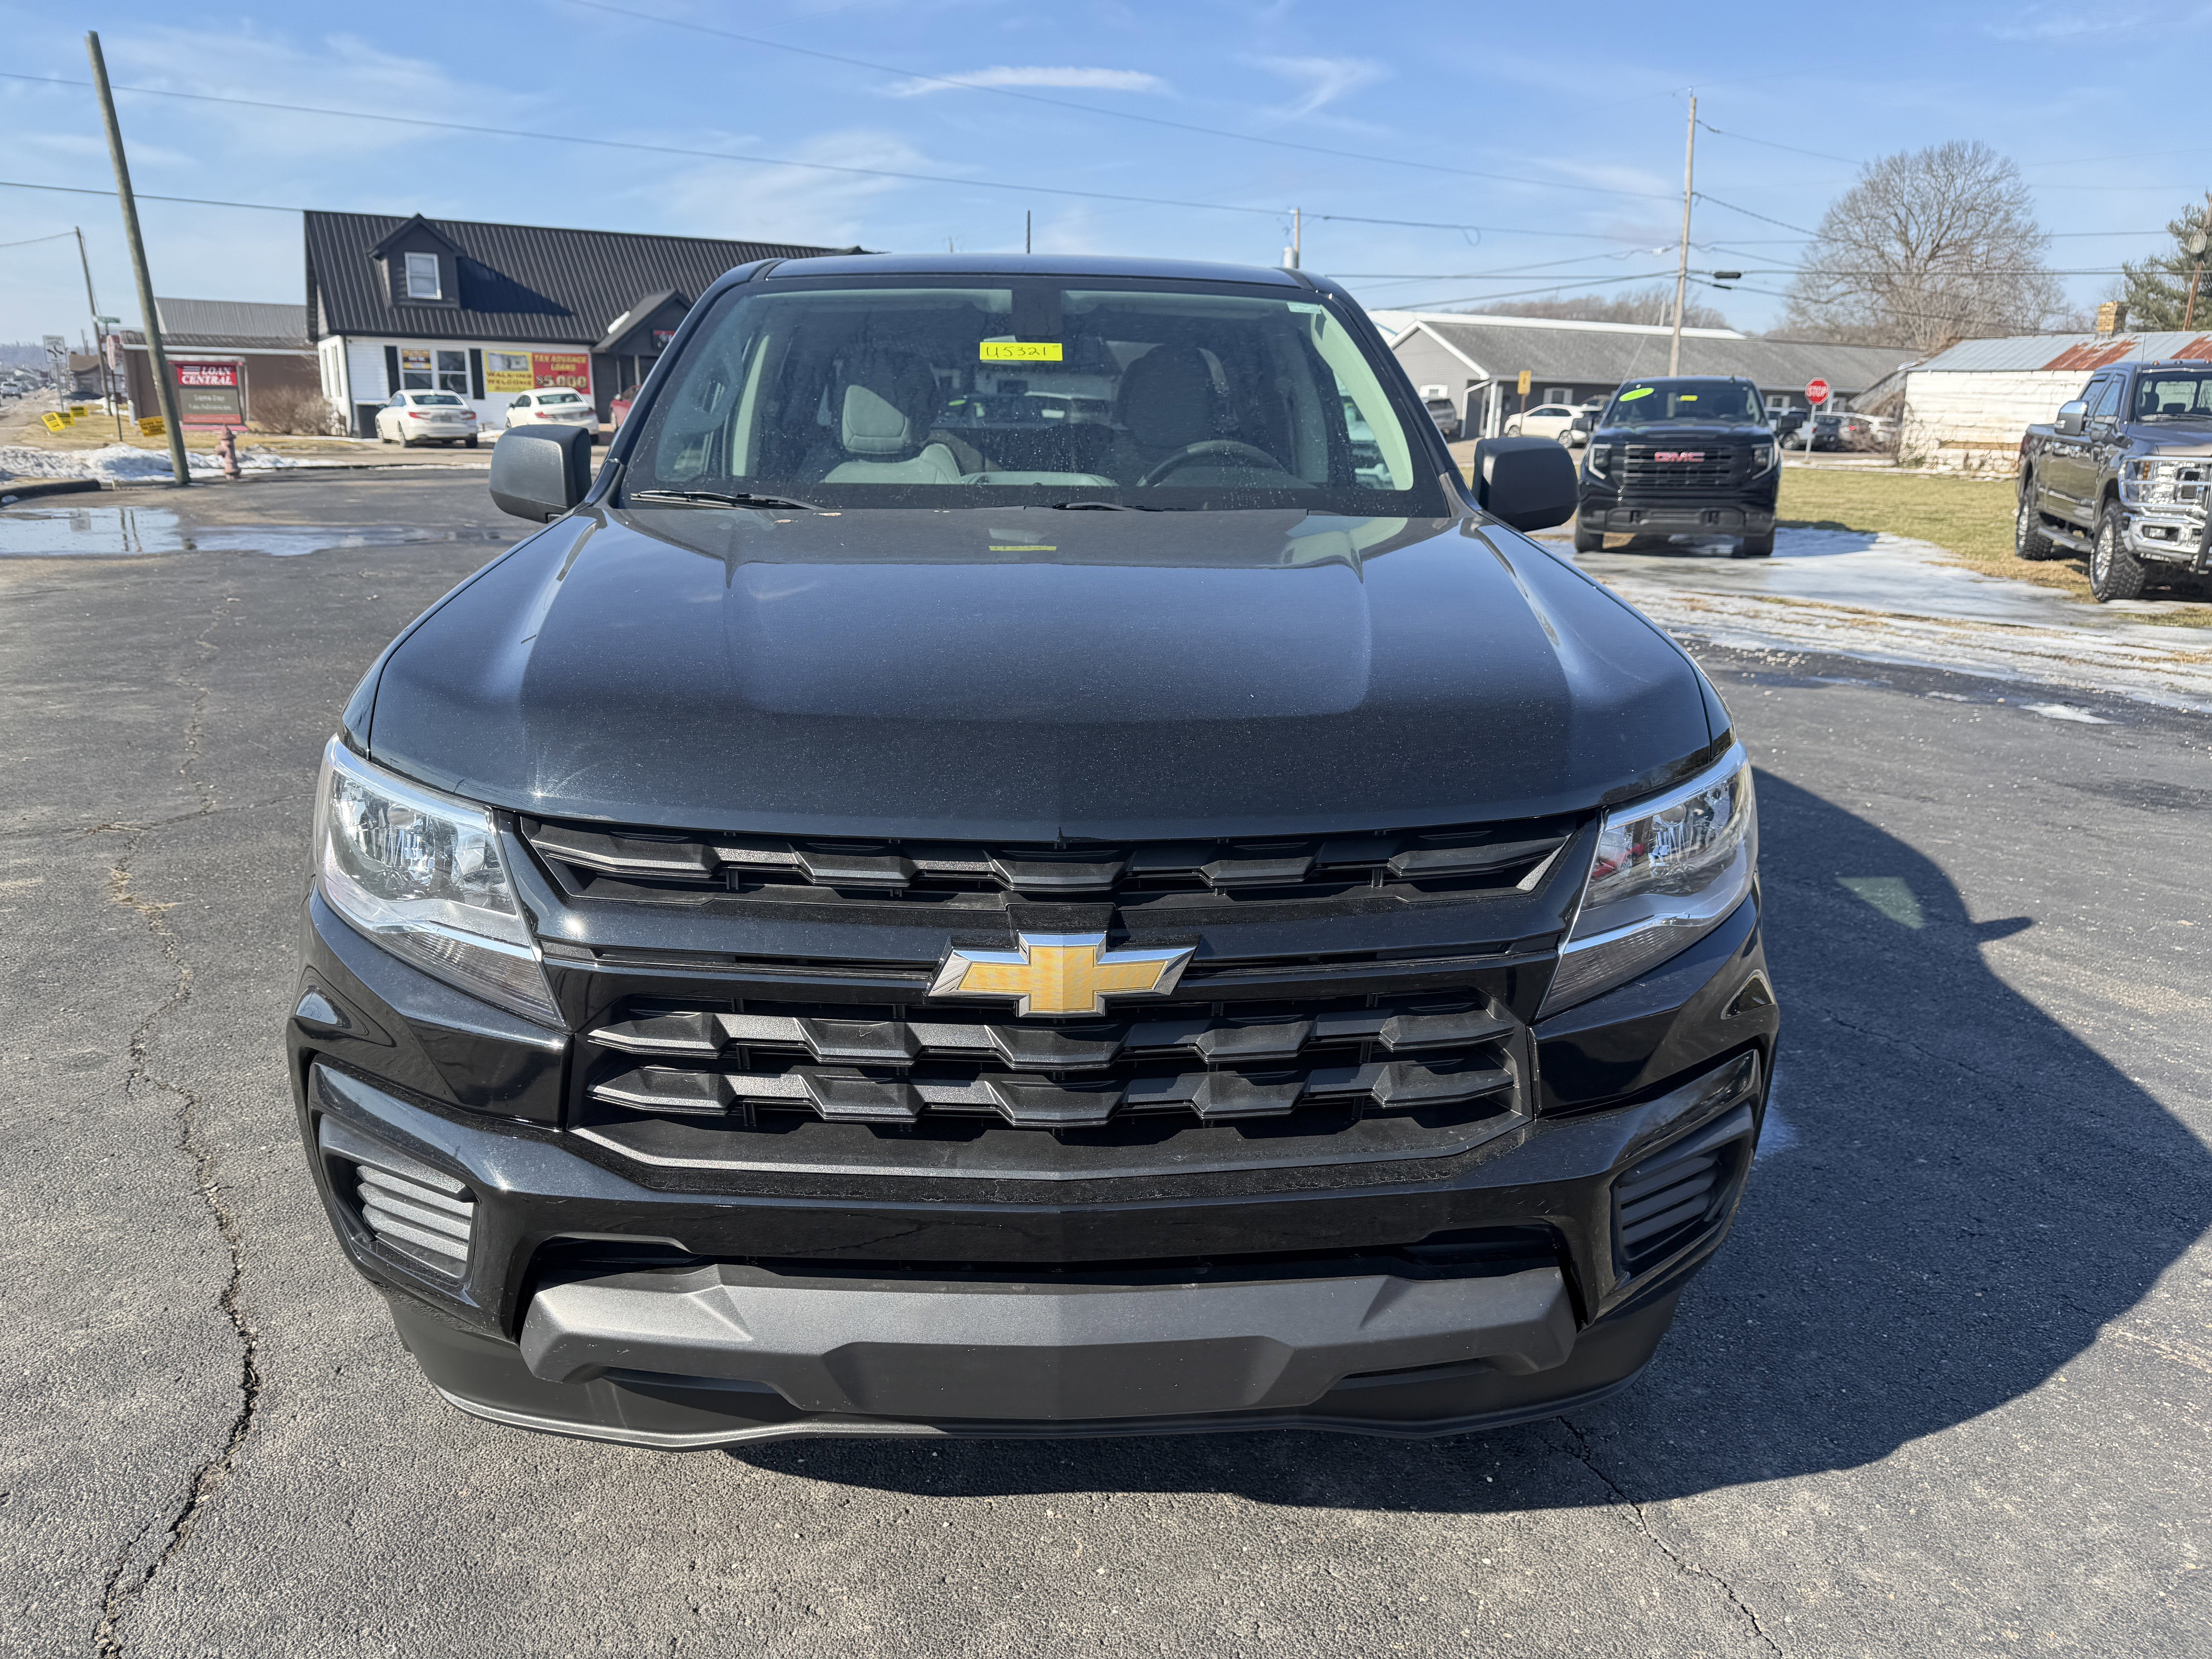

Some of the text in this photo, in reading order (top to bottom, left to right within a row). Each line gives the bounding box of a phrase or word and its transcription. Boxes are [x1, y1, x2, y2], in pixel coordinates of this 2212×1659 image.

[534, 354, 587, 364] TAX ADVANCE
[201, 366, 232, 376] LOAN
[550, 363, 576, 371] LOANS
[181, 374, 233, 385] CENTRAL
[1807, 385, 1827, 397] STOP
[1654, 451, 1706, 463] GMC
